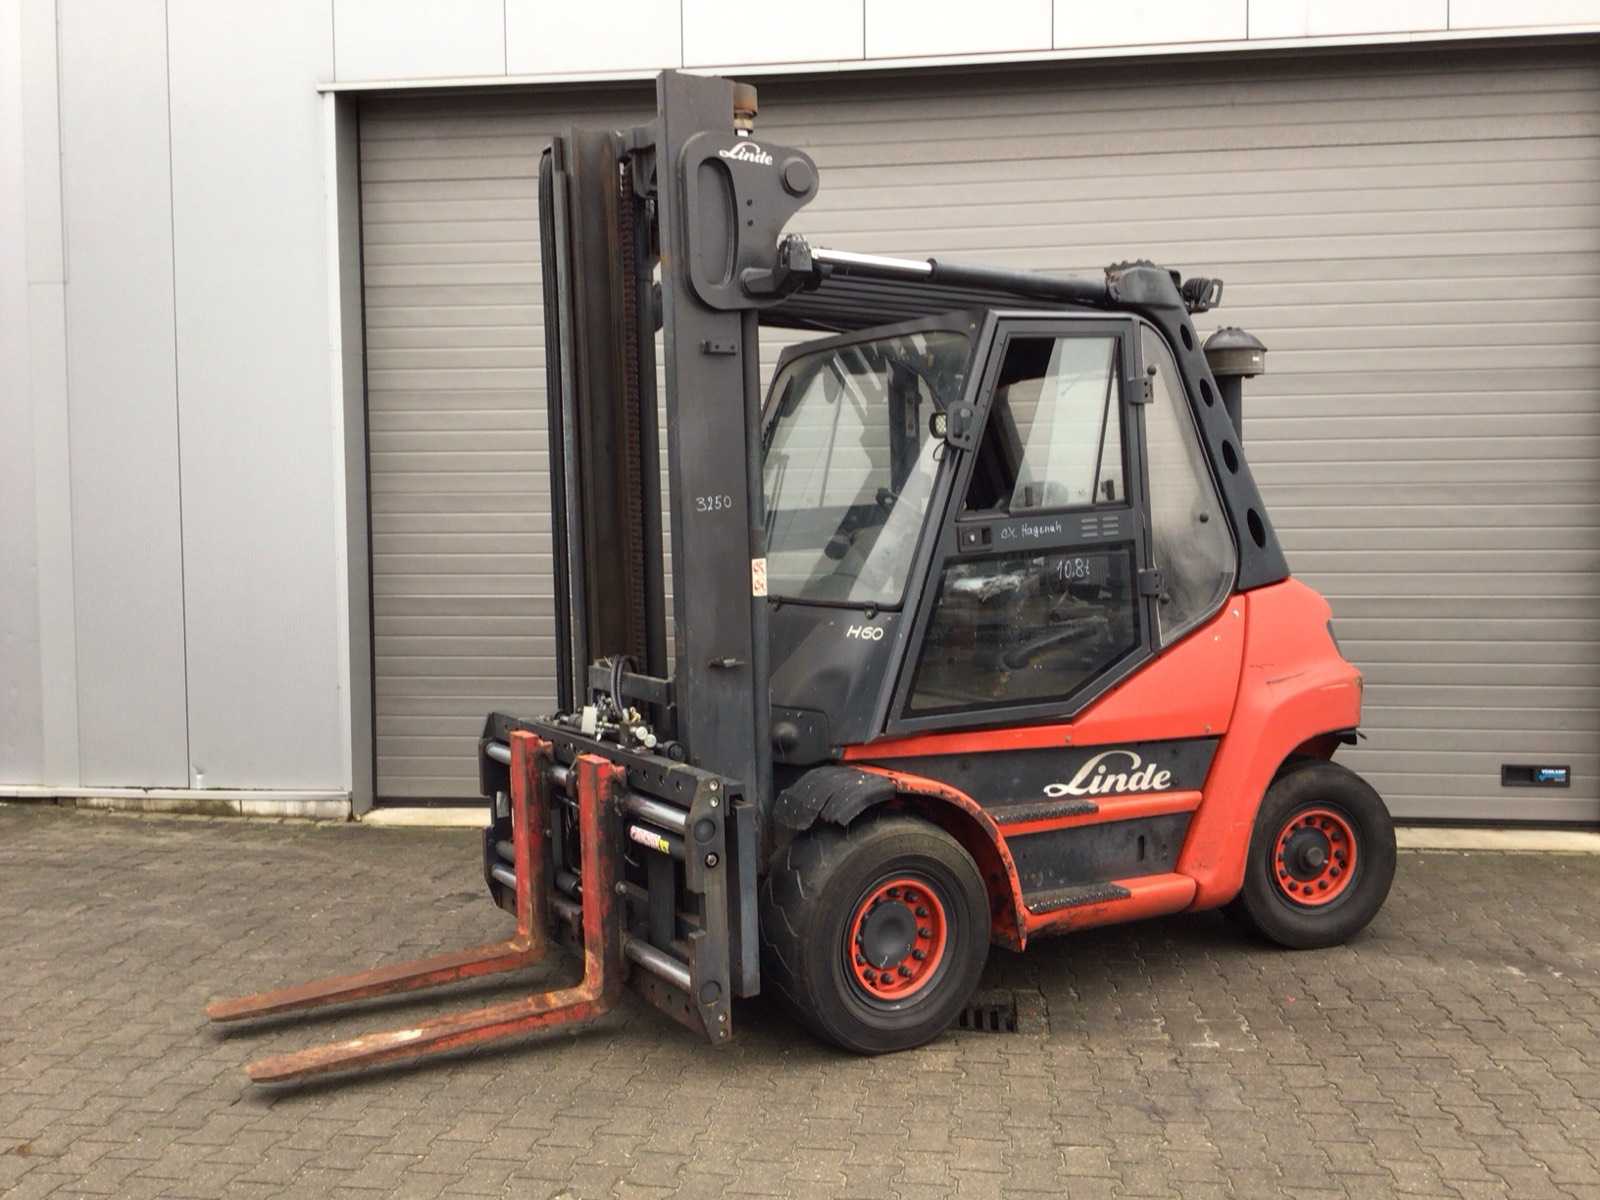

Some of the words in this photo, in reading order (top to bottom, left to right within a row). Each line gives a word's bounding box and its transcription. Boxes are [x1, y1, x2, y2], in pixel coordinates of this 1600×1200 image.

[718, 141, 773, 165] Linde
[695, 494, 732, 512] 3250
[846, 624, 884, 641] H60
[1043, 750, 1172, 797] Linde
